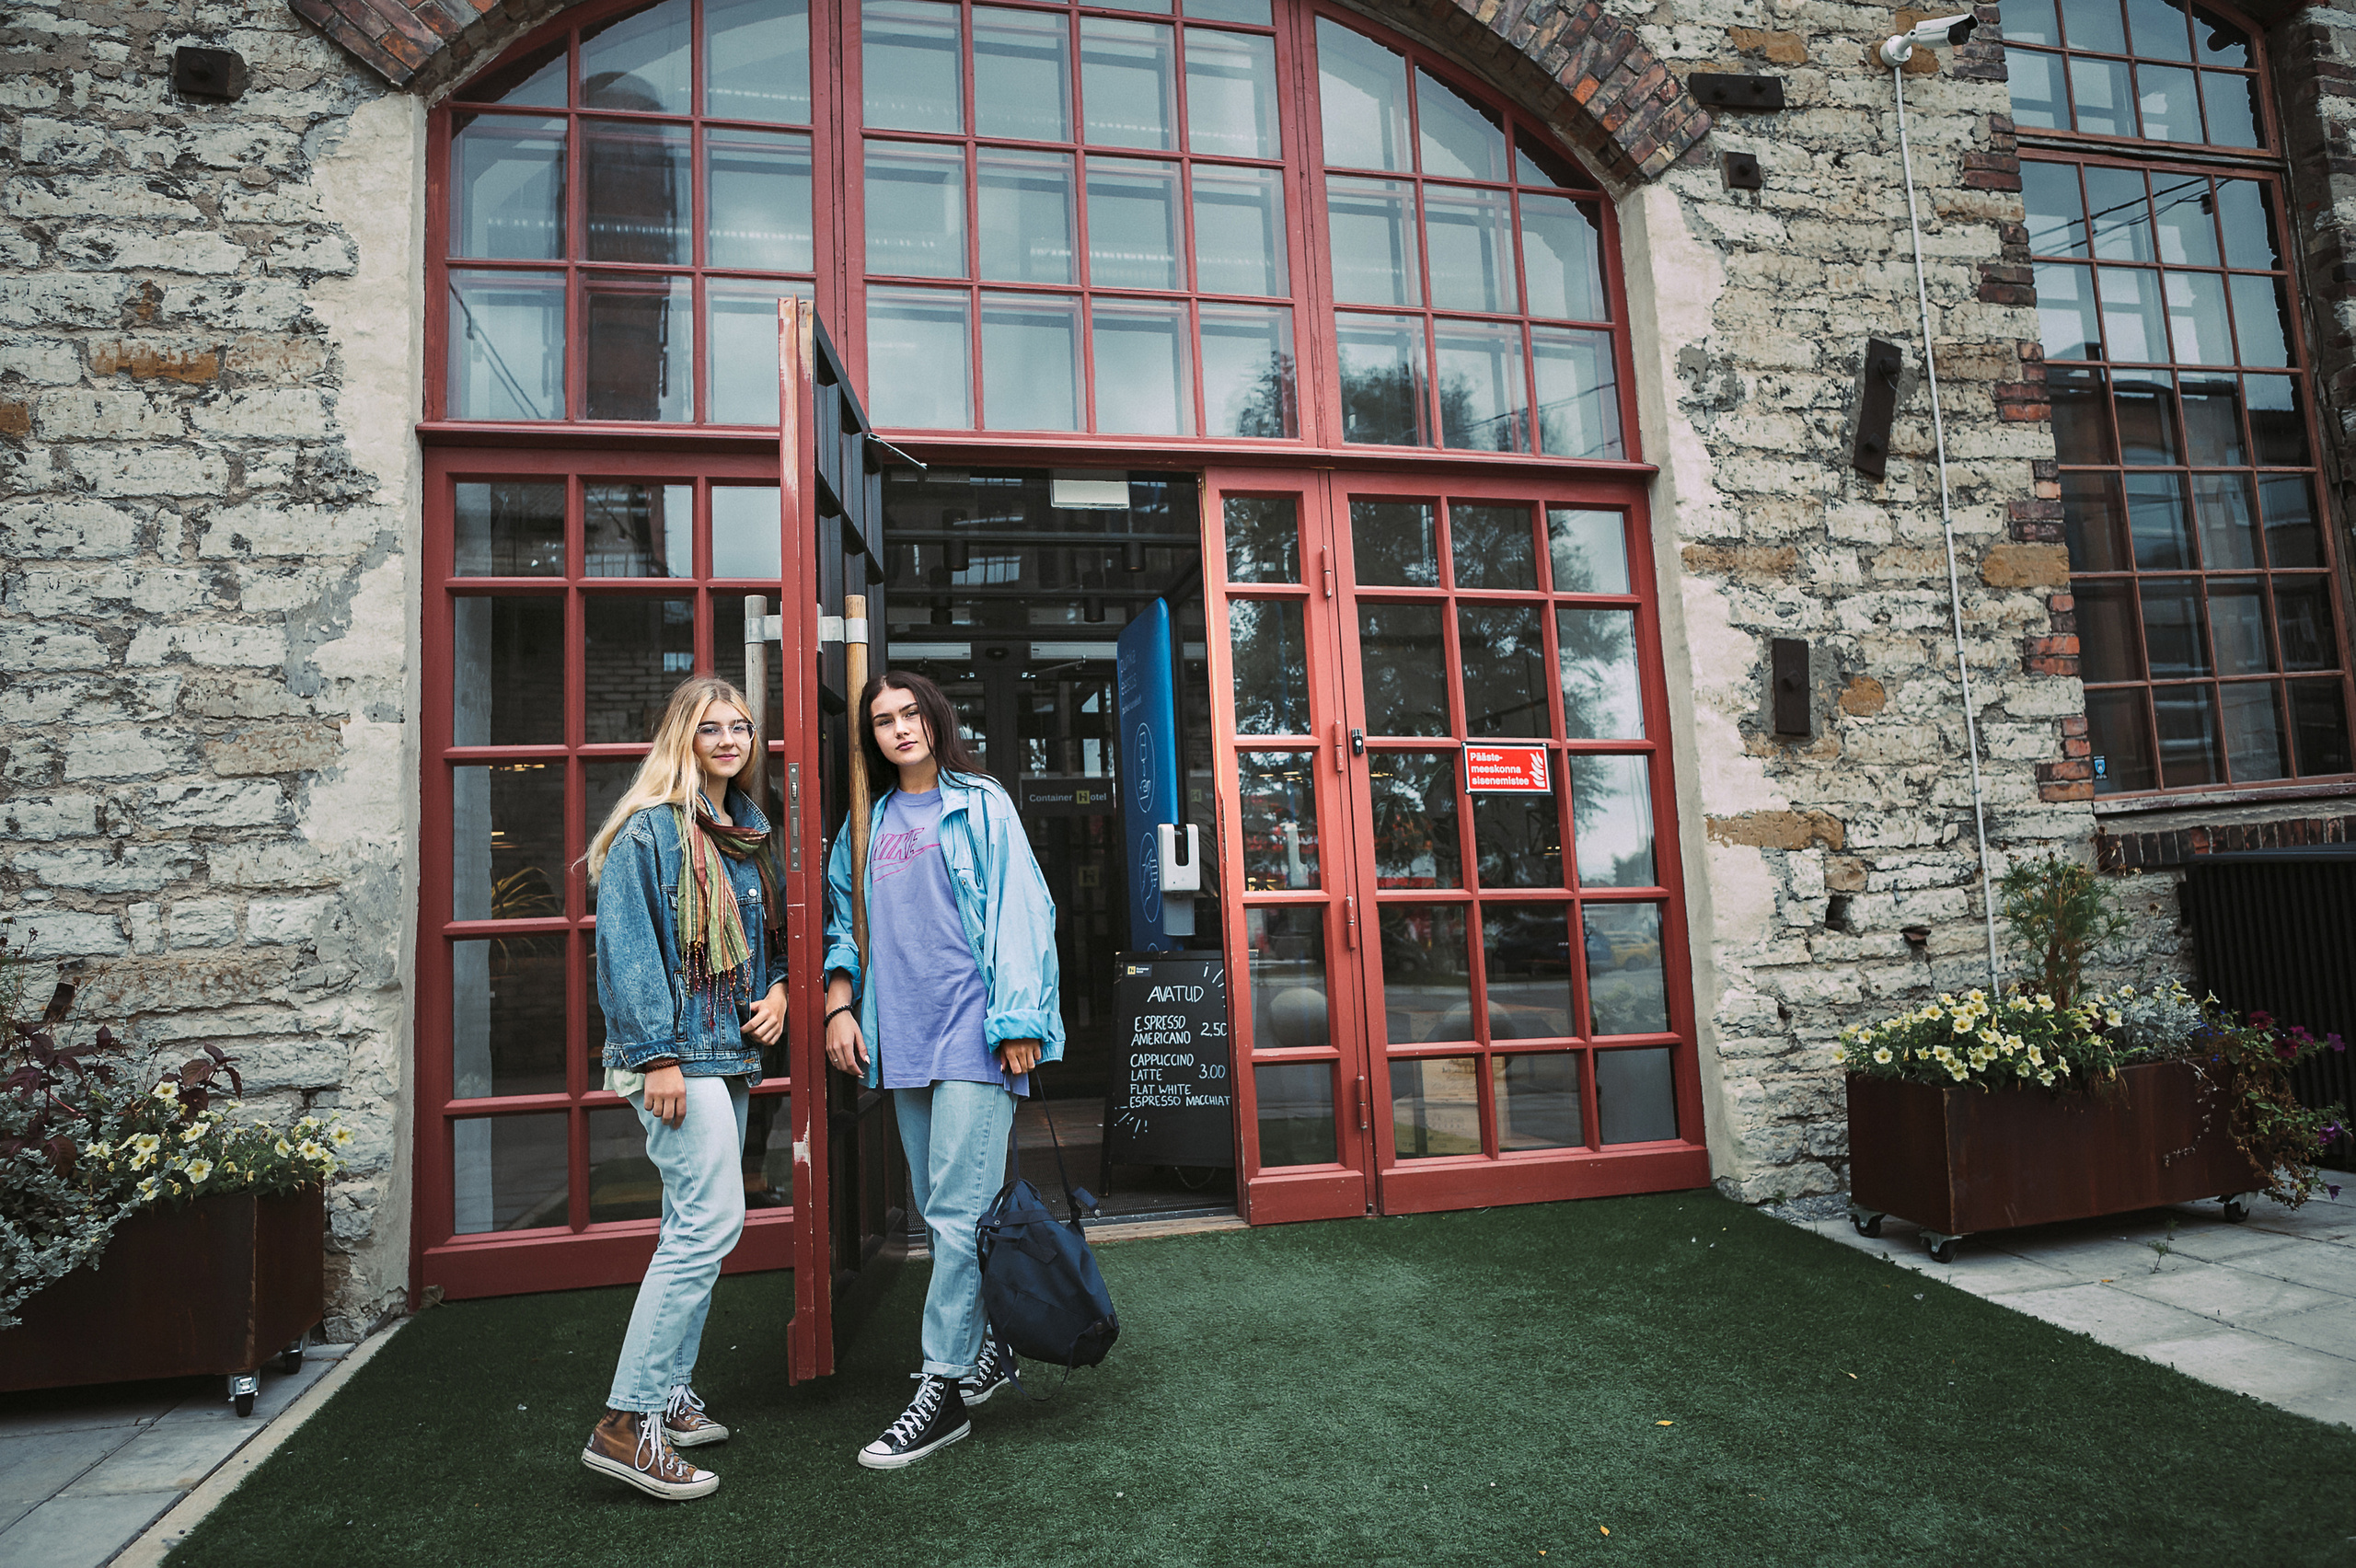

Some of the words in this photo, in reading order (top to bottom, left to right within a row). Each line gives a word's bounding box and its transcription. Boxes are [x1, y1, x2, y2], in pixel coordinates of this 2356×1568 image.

[1470, 752, 1503, 762] Pääste-
[1471, 765, 1521, 774] meeskonna
[1472, 776, 1530, 786] sisenemistee
[1029, 793, 1073, 802] Container
[871, 826, 925, 861] NIKE
[1147, 985, 1205, 1003] AVATUD
[1134, 1014, 1186, 1032] ESPRESSO
[1130, 1031, 1191, 1047] AMERICANO
[1130, 1053, 1195, 1067] CAPPUCCINO
[1130, 1068, 1163, 1082] LATTE
[1198, 1063, 1226, 1079] 3.00
[1130, 1083, 1156, 1095] FLAT
[1158, 1083, 1192, 1096] WHITE
[1129, 1095, 1181, 1109] ESPRESSO
